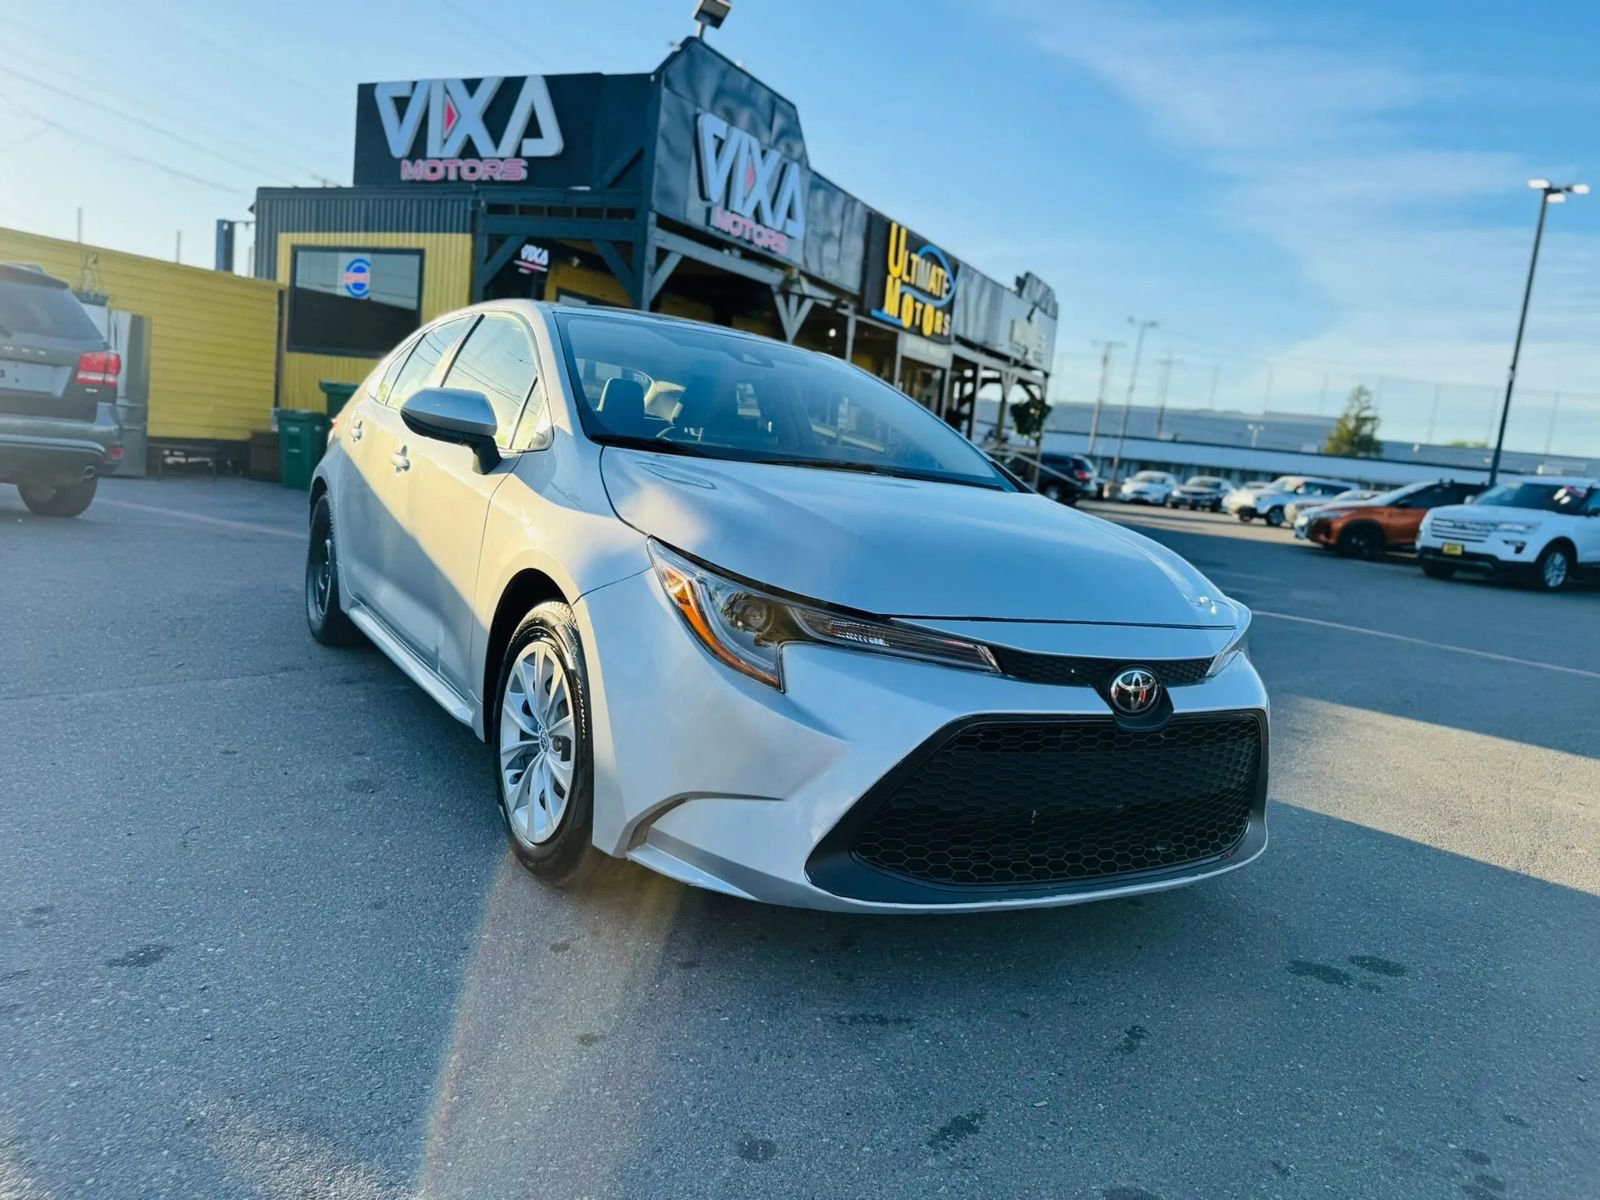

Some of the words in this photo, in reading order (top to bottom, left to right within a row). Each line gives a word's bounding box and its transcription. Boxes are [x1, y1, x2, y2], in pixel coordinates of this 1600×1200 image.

[374, 74, 564, 159] VIXA
[400, 158, 528, 182] MOTORS
[697, 112, 806, 240] VIXA
[715, 206, 789, 255] MOTORS
